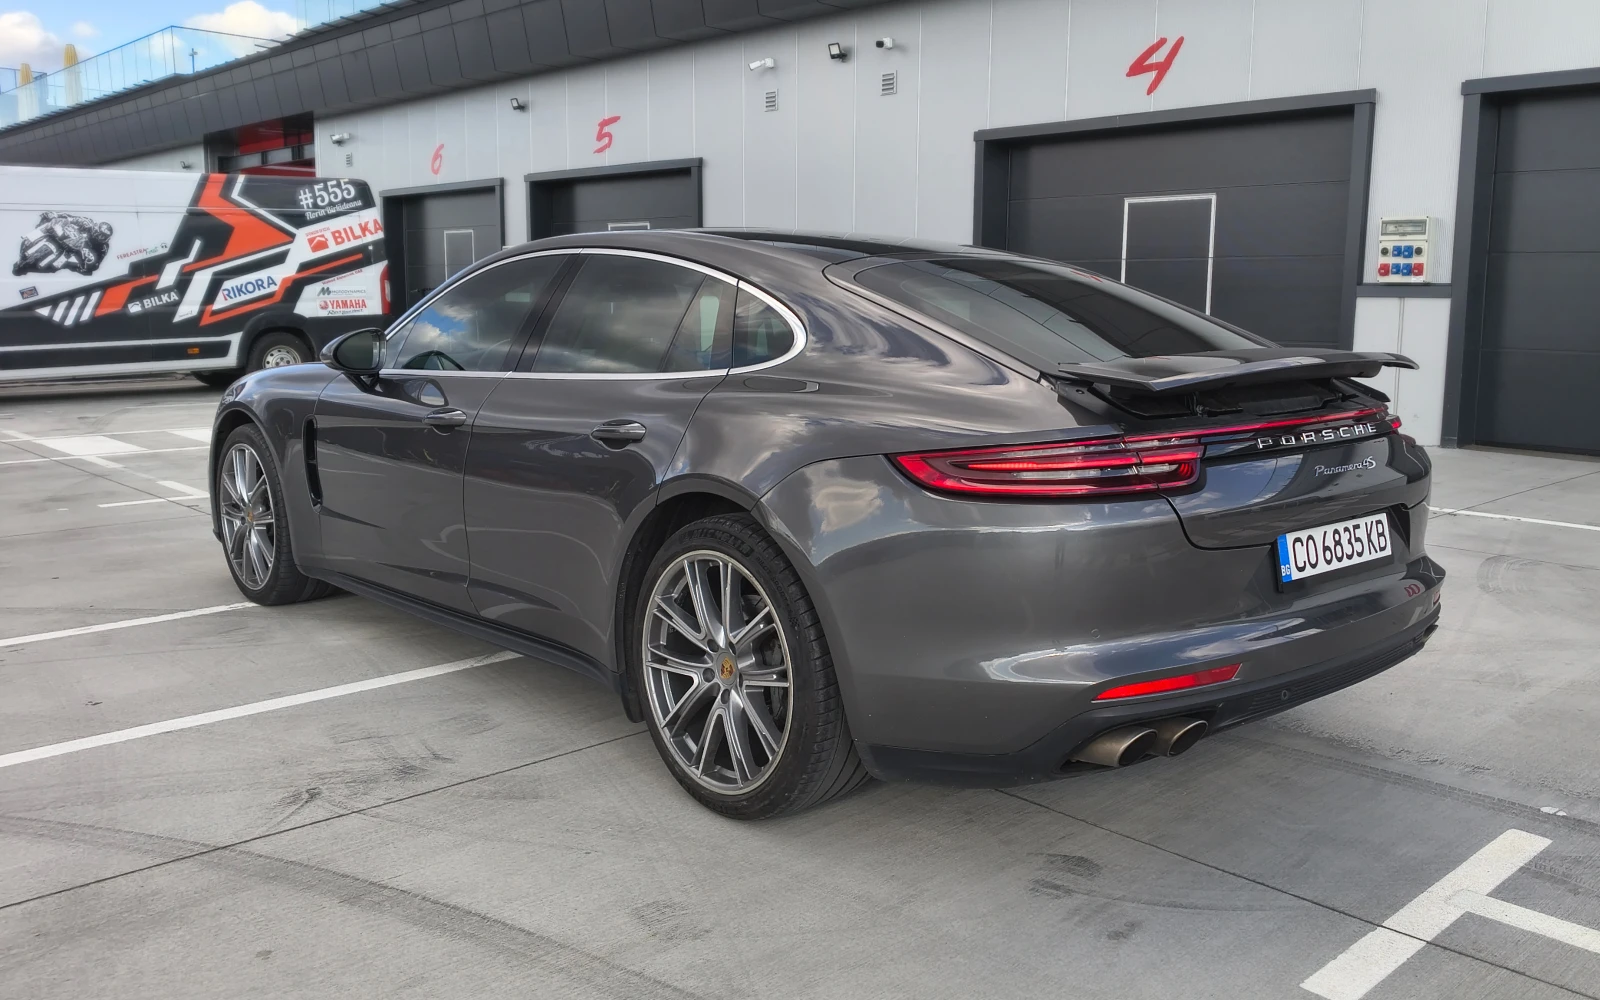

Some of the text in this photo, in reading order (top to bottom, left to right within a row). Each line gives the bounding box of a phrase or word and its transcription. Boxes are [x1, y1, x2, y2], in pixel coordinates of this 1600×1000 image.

[1126, 36, 1185, 96] 4
[592, 115, 621, 154] 5
[430, 143, 445, 175] 6
[298, 178, 356, 210] #555
[330, 218, 384, 247] BILKA
[142, 291, 179, 309] BILKA
[221, 275, 278, 302] RIKORA
[329, 299, 367, 310] YAMAHA
[1256, 422, 1378, 449] PORSCHE
[1292, 534, 1320, 573] CO
[1322, 523, 1365, 566] 6835
[1281, 565, 1292, 577] BG
